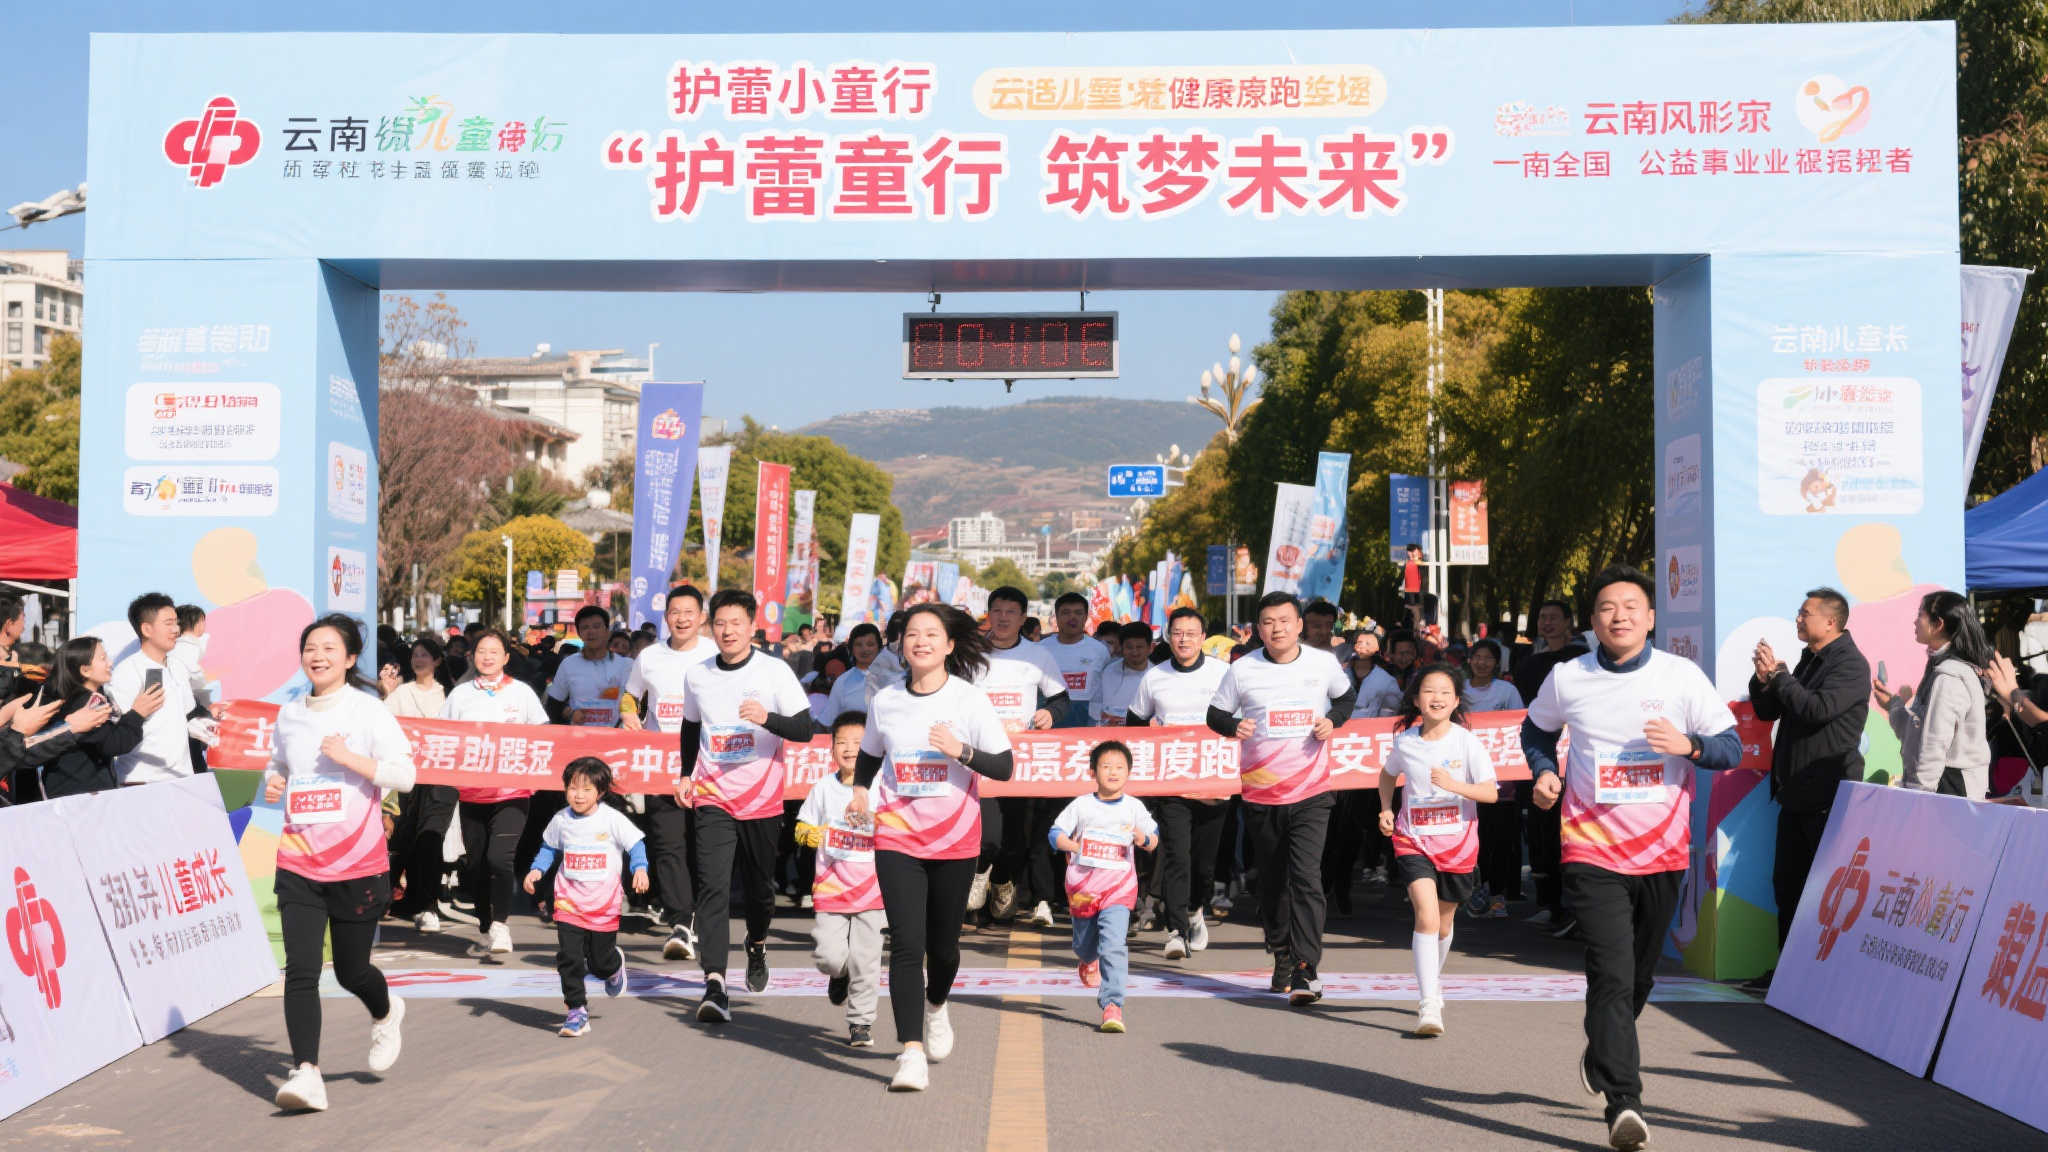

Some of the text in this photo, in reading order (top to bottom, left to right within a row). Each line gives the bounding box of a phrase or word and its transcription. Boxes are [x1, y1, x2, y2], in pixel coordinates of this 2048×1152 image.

[673, 65, 932, 115] 护蕾小童行
